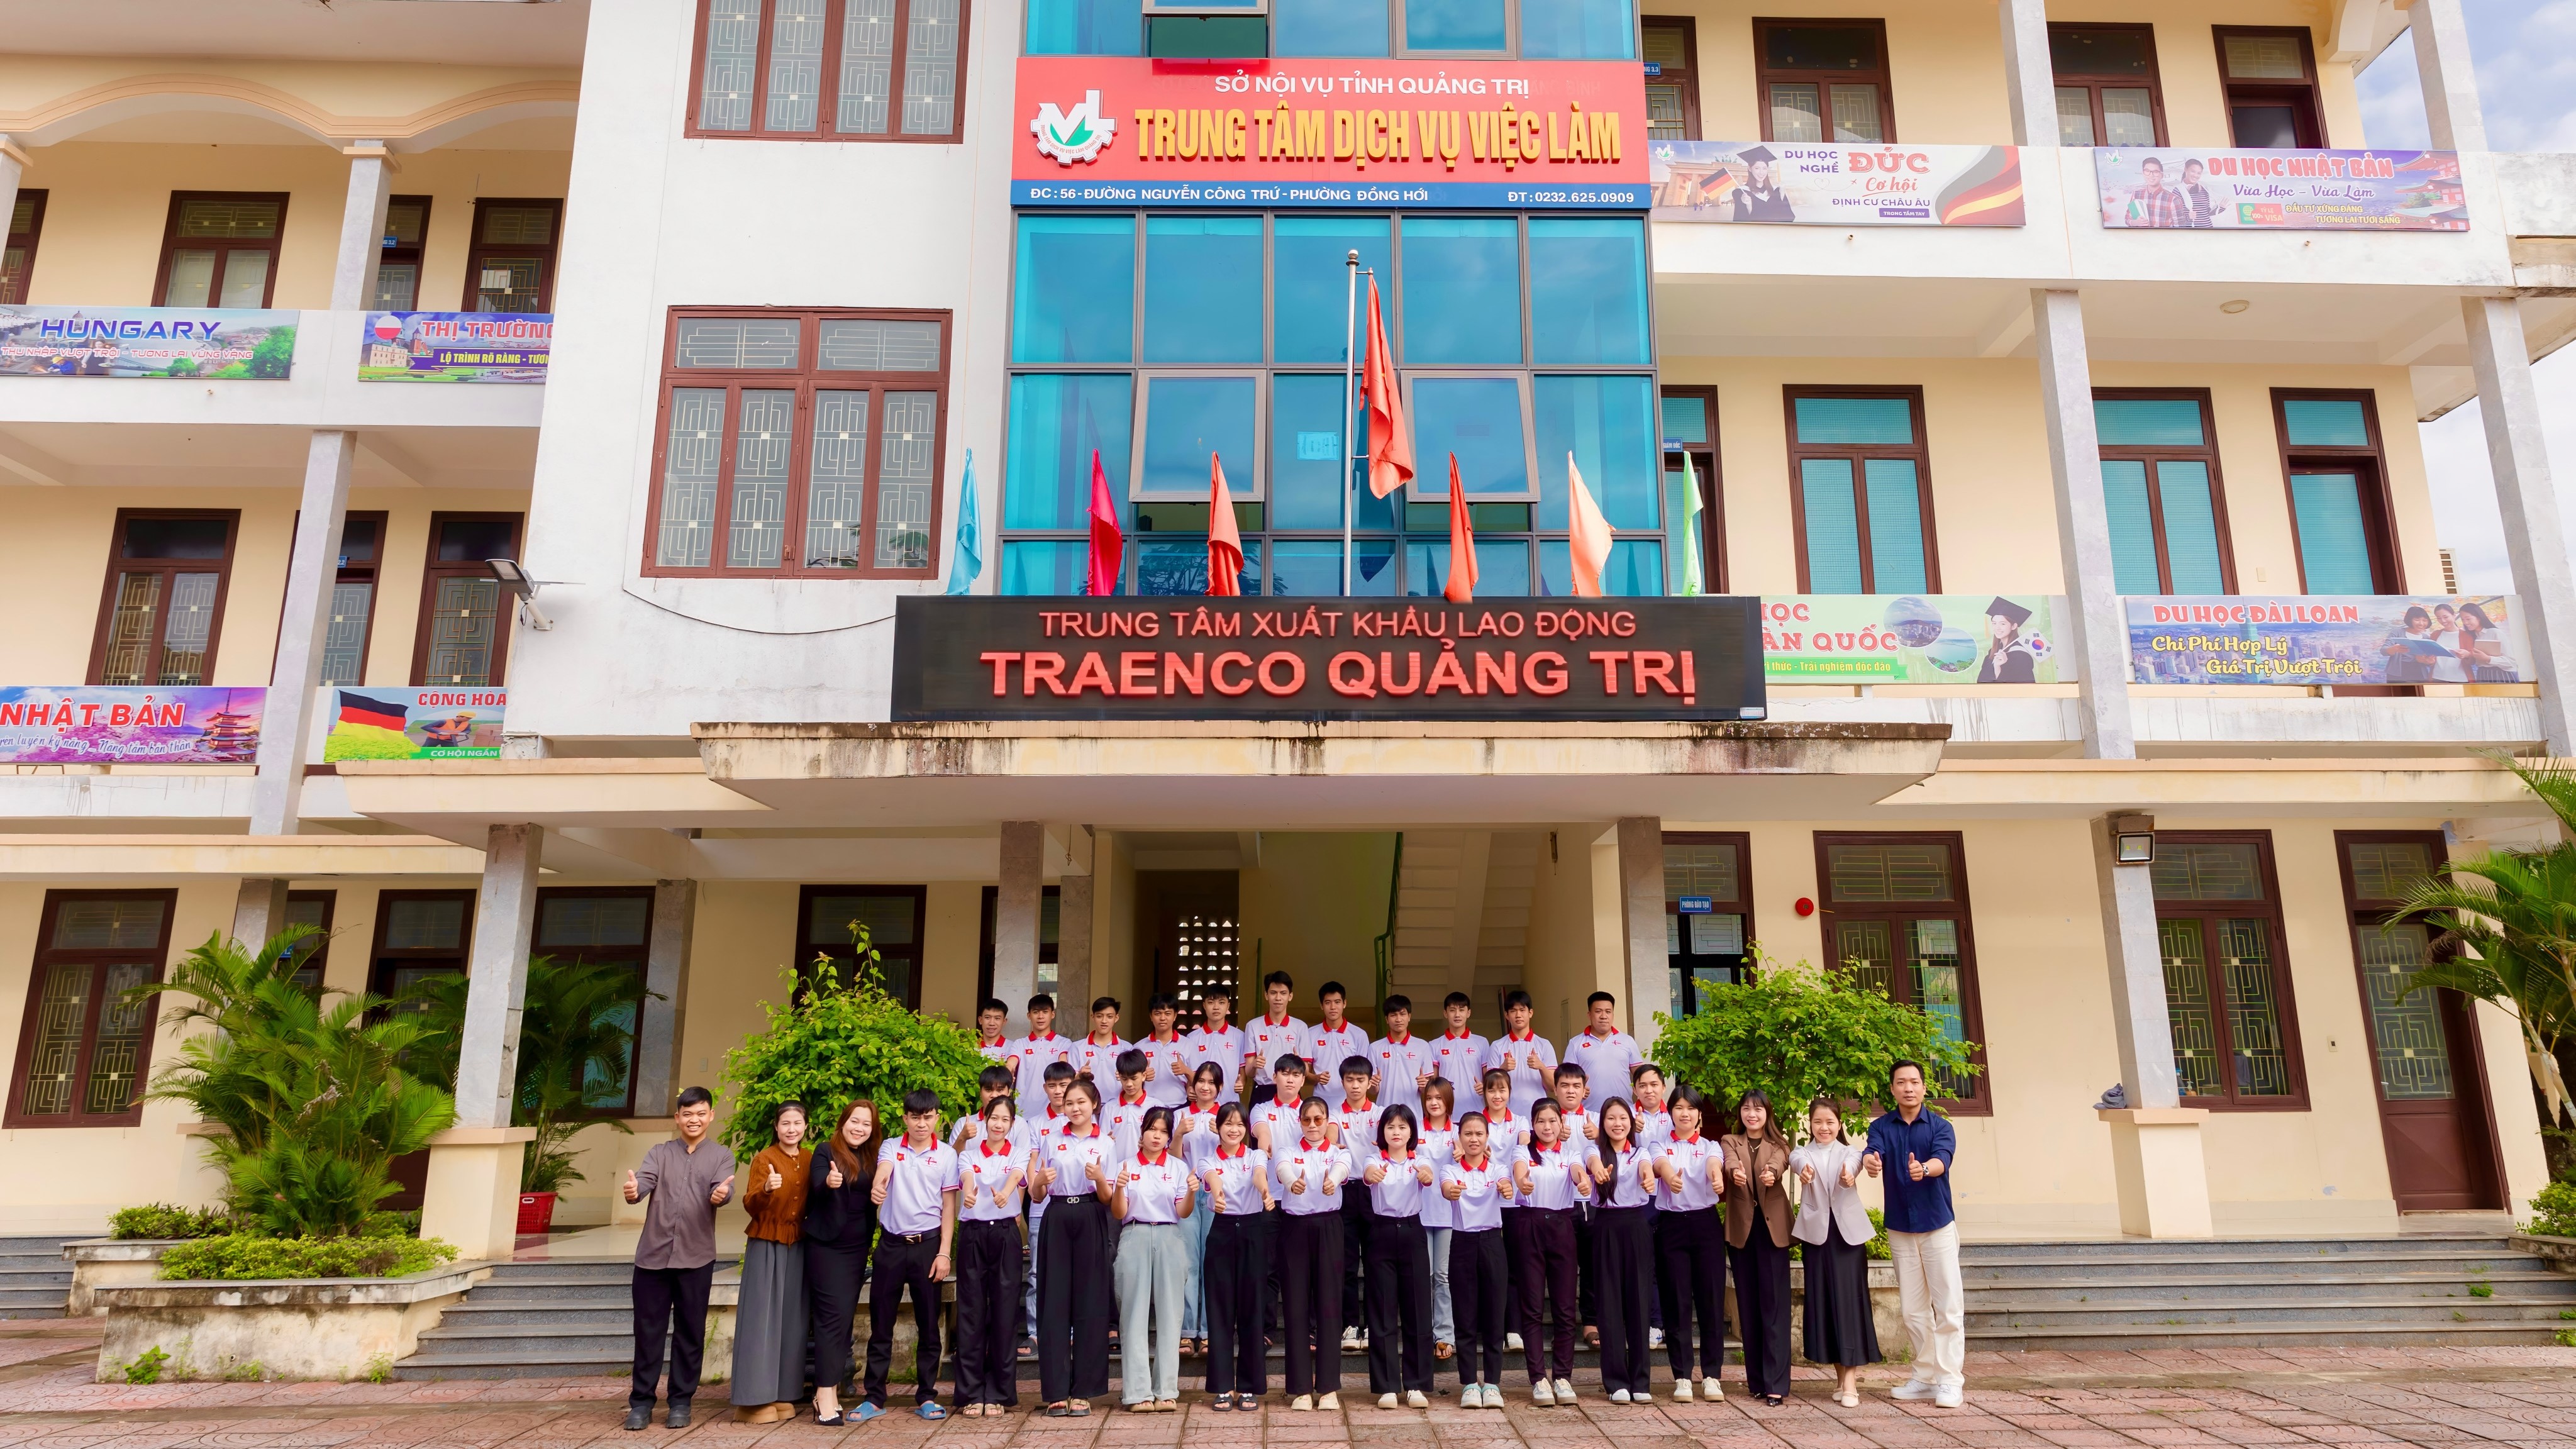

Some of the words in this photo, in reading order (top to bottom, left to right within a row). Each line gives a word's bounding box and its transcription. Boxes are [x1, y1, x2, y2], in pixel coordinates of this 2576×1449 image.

[1215, 69, 1250, 93] SỞ
[1255, 72, 1296, 97] NỘI
[1301, 77, 1333, 98] VỤ
[1339, 70, 1393, 94] TỈNH
[1398, 71, 1486, 95] QUẢNG
[1491, 79, 1529, 99] TRỊ
[1135, 108, 1246, 162] TRUNG
[1254, 100, 1326, 162] TÂM
[1333, 109, 1409, 170] DỊCH
[1417, 109, 1460, 172] VỤ
[1468, 101, 1541, 172] VIỆC
[1547, 101, 1621, 164] LÀM
[1785, 150, 1803, 158] DU
[1807, 151, 1838, 161] HỌC
[1848, 147, 1931, 174] ĐỨC
[1800, 161, 1839, 173] NGHỀ
[2207, 157, 2238, 176] DU
[2241, 157, 2284, 180] HỌC
[2287, 153, 2345, 180] NHẬT
[2350, 152, 2394, 178] BẢN
[1141, 184, 1200, 201] NGUYỄN
[1204, 186, 1246, 200] CÔNG
[1357, 186, 1399, 201] ĐỒNG
[1404, 189, 1428, 201] HỚI
[1865, 177, 1887, 191] Cơ
[1890, 177, 1918, 193] hội
[2233, 184, 2262, 197] Vừa
[2265, 184, 2295, 199] Học
[2311, 185, 2341, 197] Vừa
[2343, 185, 2375, 201] Làm
[1882, 197, 1912, 206] CHÂU
[1915, 197, 1930, 206] ÂU
[2379, 214, 2401, 225] SÁNG
[40, 318, 222, 341] HUNGARY
[421, 321, 458, 341] THỊ
[1, 347, 24, 355] THU
[27, 346, 58, 357] NHẬP
[60, 348, 92, 358] VƯỢT
[94, 347, 119, 358] TRỘI
[131, 350, 169, 358] TƯƠNG
[223, 348, 253, 358] VÀNG
[440, 352, 452, 365] LỘ
[453, 352, 480, 364] TRÌNH
[482, 352, 494, 364] RÕ
[496, 352, 521, 364] RÀNG
[2153, 605, 2189, 623] DU
[2193, 604, 2245, 627] HỌC
[2249, 600, 2292, 623] ĐÀI
[2296, 604, 2360, 623] LOAN
[1039, 611, 1159, 638] TRUNG
[1170, 606, 1240, 638] TÂM
[1252, 604, 1343, 638] XUẤT
[1353, 605, 1446, 638] KHẨU
[1458, 612, 1524, 638] LAO
[1535, 609, 1636, 641] ĐỘNG
[1762, 626, 1804, 652] ÀN
[1813, 624, 1899, 652] QUỐC
[2151, 635, 2186, 652] Chi
[2187, 635, 2224, 652] Phí
[2224, 636, 2262, 656] Hợp
[2265, 636, 2287, 655] Lý
[980, 651, 1306, 697] TRAENCO
[1328, 638, 1569, 698] QUẢNG
[1590, 650, 1695, 705] TRỊ
[1772, 661, 1792, 671] thức
[1800, 660, 1817, 671] Trải
[1819, 662, 1853, 673] nghiệm
[1856, 662, 1872, 673] độc
[2206, 658, 2241, 674] Giá
[2241, 659, 2272, 676] Trị
[2273, 659, 2321, 675] Vượt
[2322, 658, 2362, 676] Trội
[418, 691, 467, 708] CỘNG
[472, 691, 507, 706] HÒA
[0, 697, 101, 733] NHẬT
[108, 695, 187, 728] BẢN
[170, 740, 191, 752] thân
[447, 749, 465, 758] HỘI
[1682, 899, 1694, 908] PHÒNG
